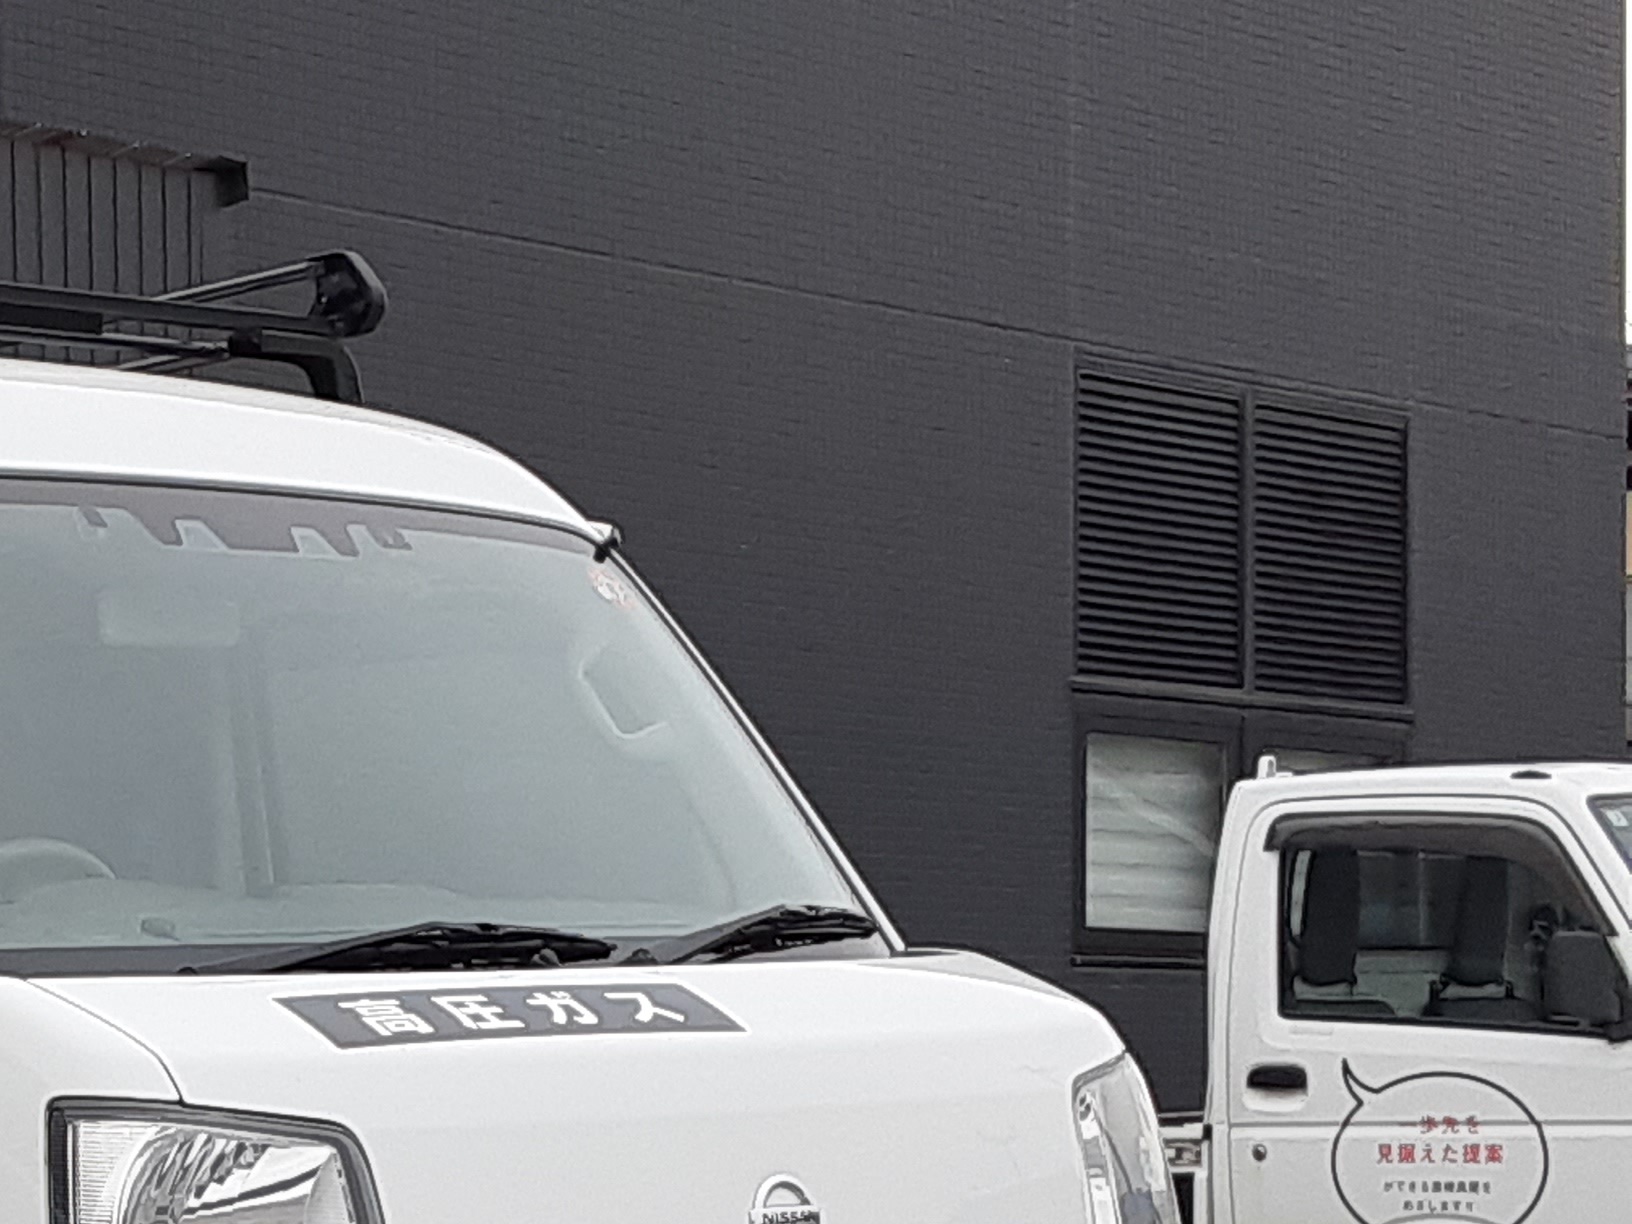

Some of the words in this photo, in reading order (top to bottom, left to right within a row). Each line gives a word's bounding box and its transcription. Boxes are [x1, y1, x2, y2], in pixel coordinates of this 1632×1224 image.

[337, 991, 686, 1036] 高圧ガス
[1377, 1143, 1504, 1165] 見据えた提案
